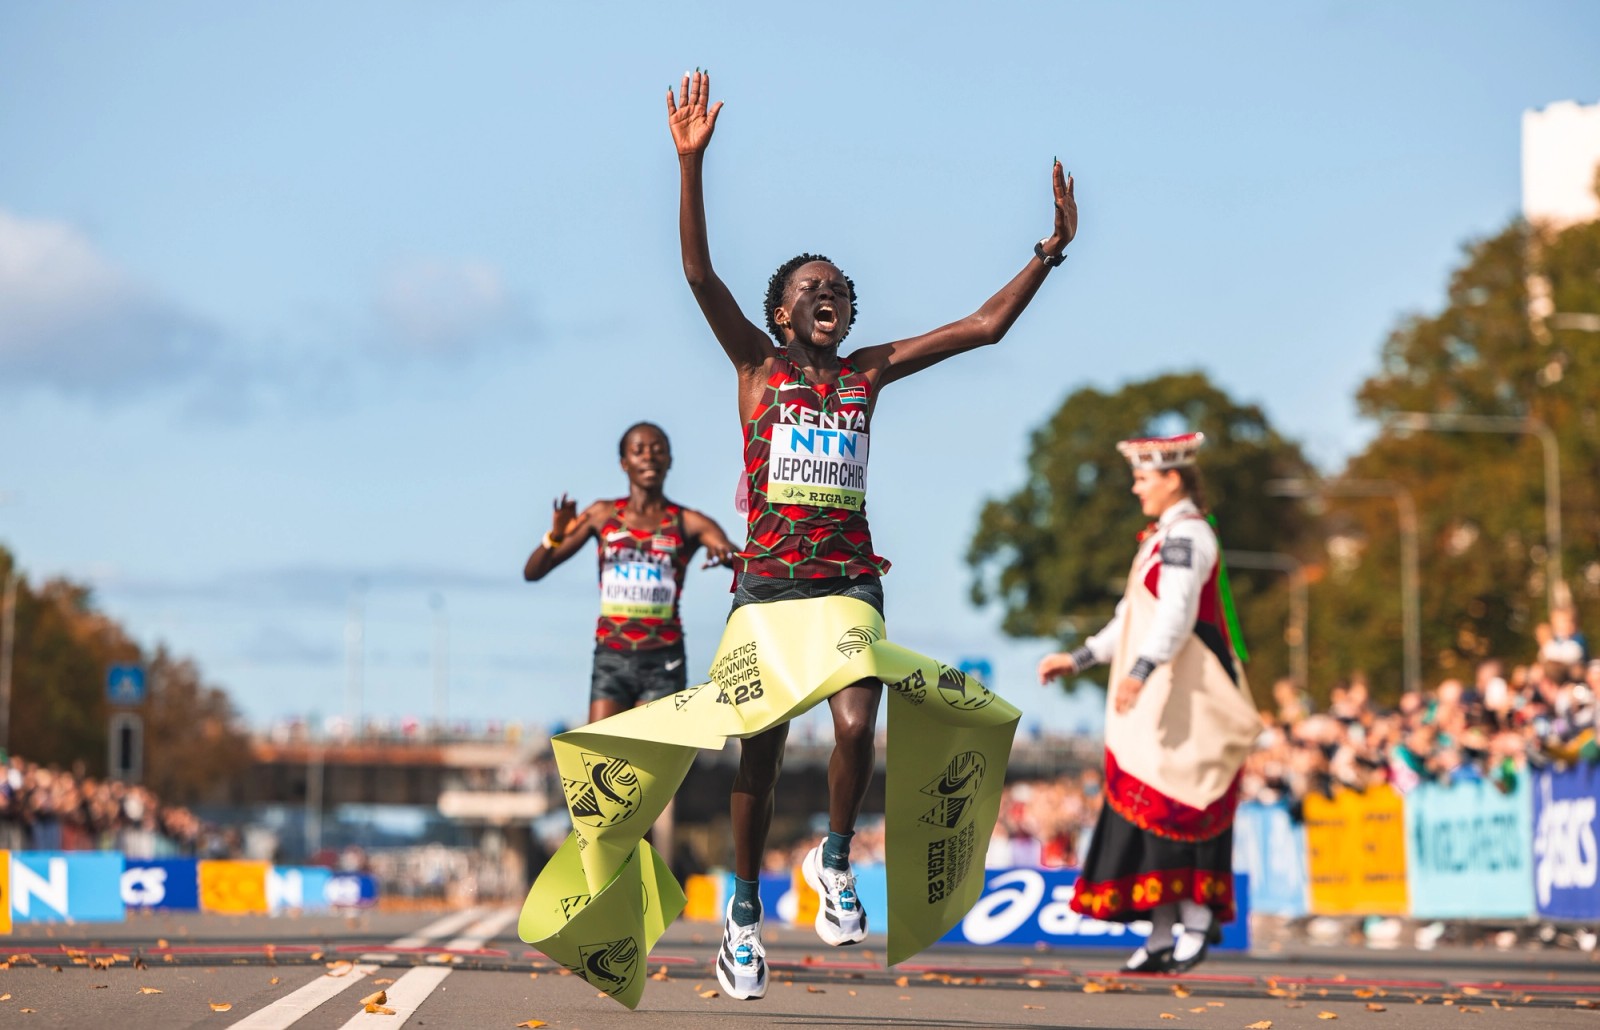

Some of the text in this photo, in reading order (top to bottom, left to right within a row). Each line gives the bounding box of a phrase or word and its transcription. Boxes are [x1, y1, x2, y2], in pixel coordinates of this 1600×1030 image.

[779, 403, 867, 431] KENYA
[790, 427, 857, 459] NTN
[773, 457, 865, 490] JEPCHIRCHIR
[808, 491, 857, 506] RIGA 23
[614, 563, 662, 581] NTN
[717, 652, 758, 681] RUNNING
[718, 641, 757, 669] ATHLETICS
[734, 679, 764, 706] 23
[928, 839, 946, 904] RIGA 23
